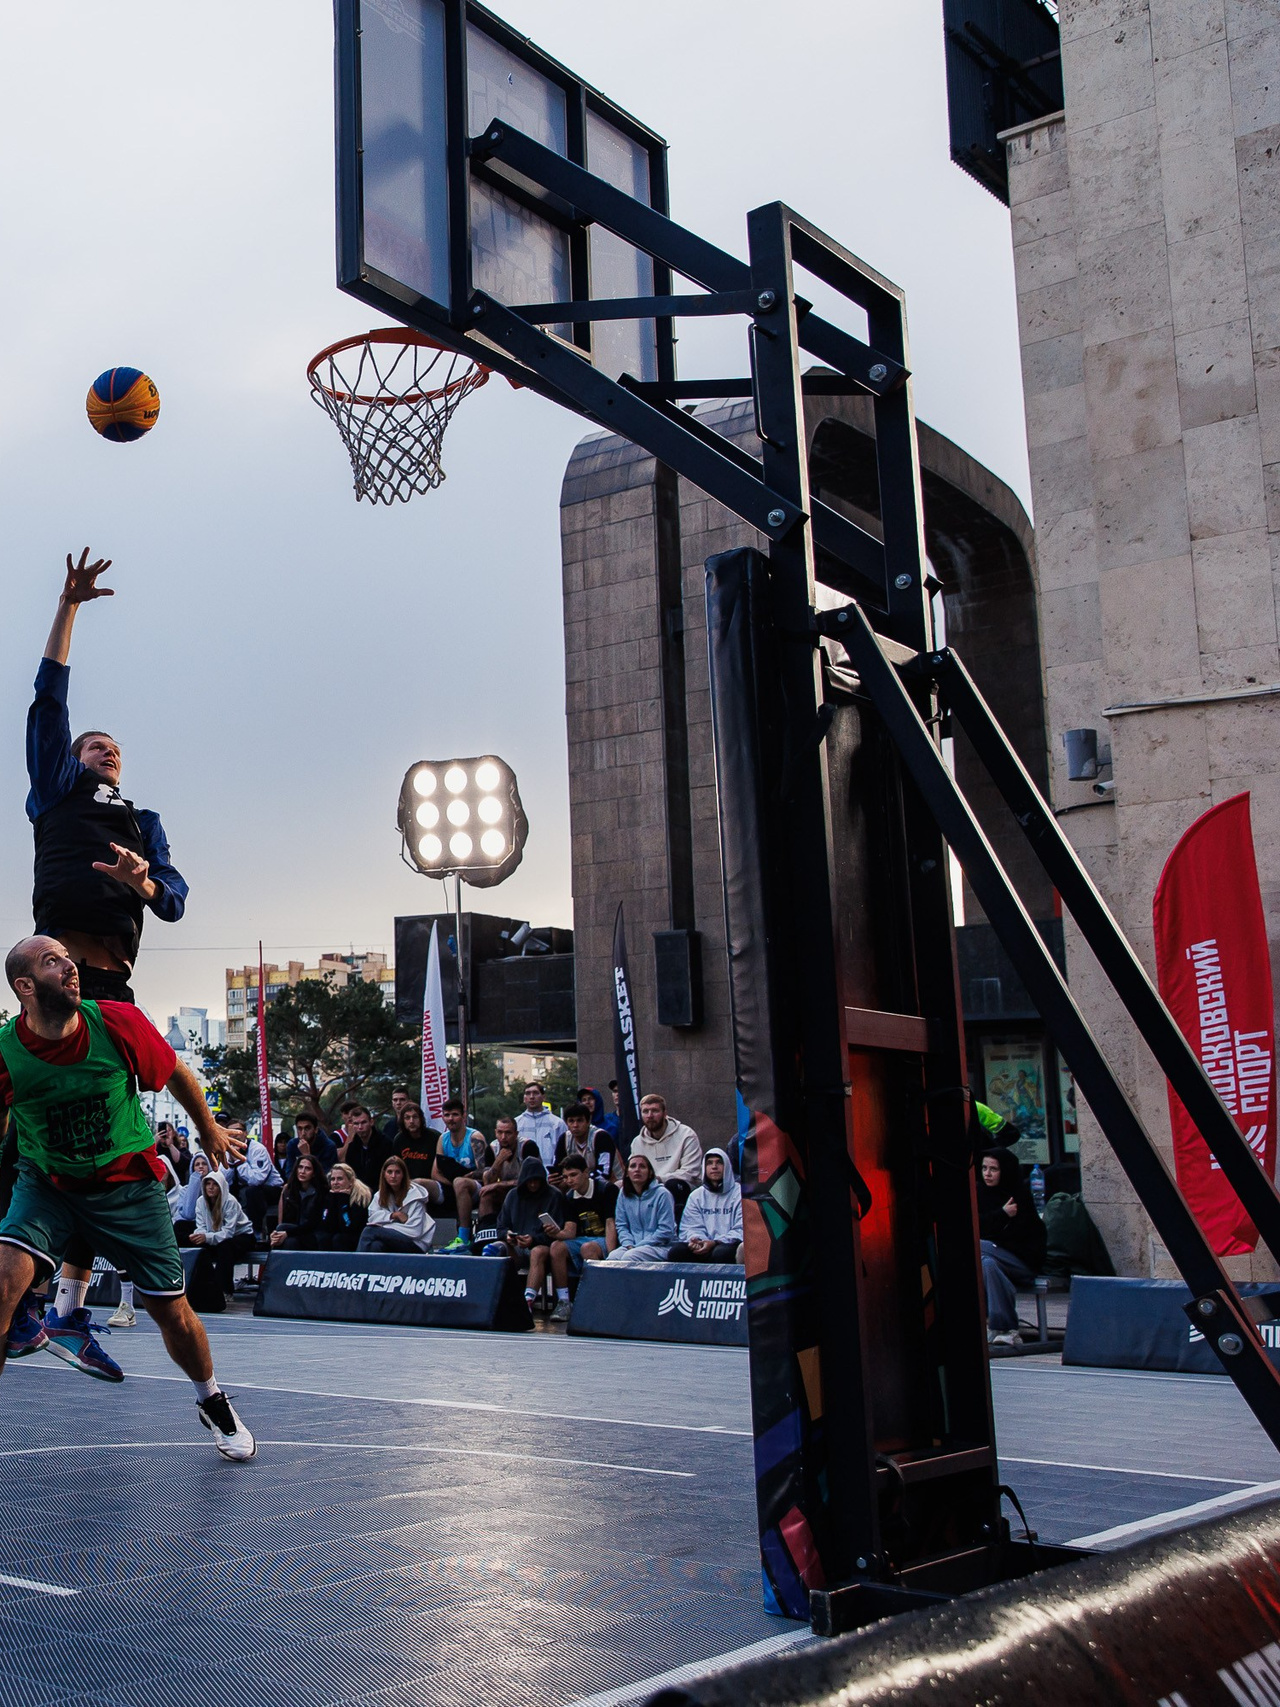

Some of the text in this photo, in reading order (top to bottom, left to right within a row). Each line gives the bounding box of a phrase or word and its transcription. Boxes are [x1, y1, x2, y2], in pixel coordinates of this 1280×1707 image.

[1234, 1030, 1271, 1114] СПОРТ
[367, 1274, 403, 1293] ТУР
[400, 1276, 467, 1298] МОСКВА
[700, 1279, 747, 1299] МОСК
[696, 1300, 744, 1320] СПОРТ
